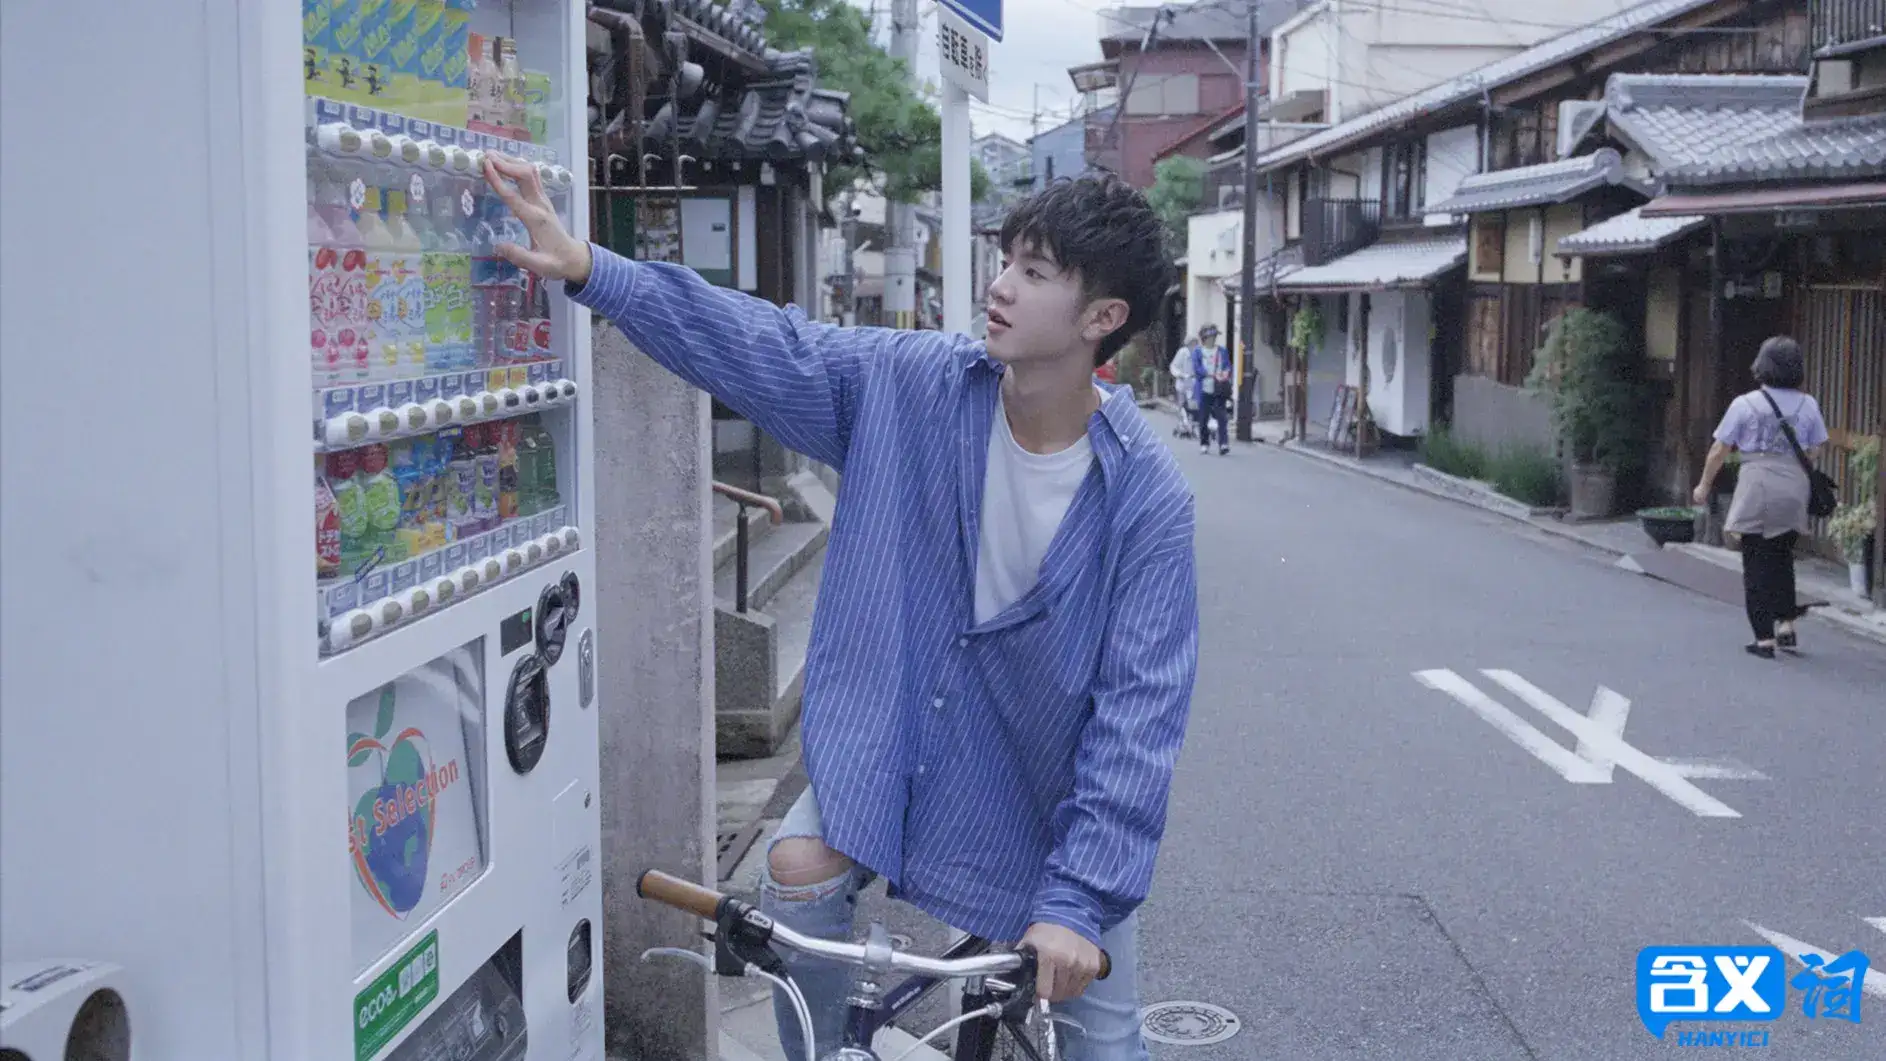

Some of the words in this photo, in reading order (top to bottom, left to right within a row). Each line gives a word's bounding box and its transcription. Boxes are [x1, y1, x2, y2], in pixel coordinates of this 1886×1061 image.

[942, 23, 988, 87] 自転車を除く
[374, 759, 459, 836] Selection
